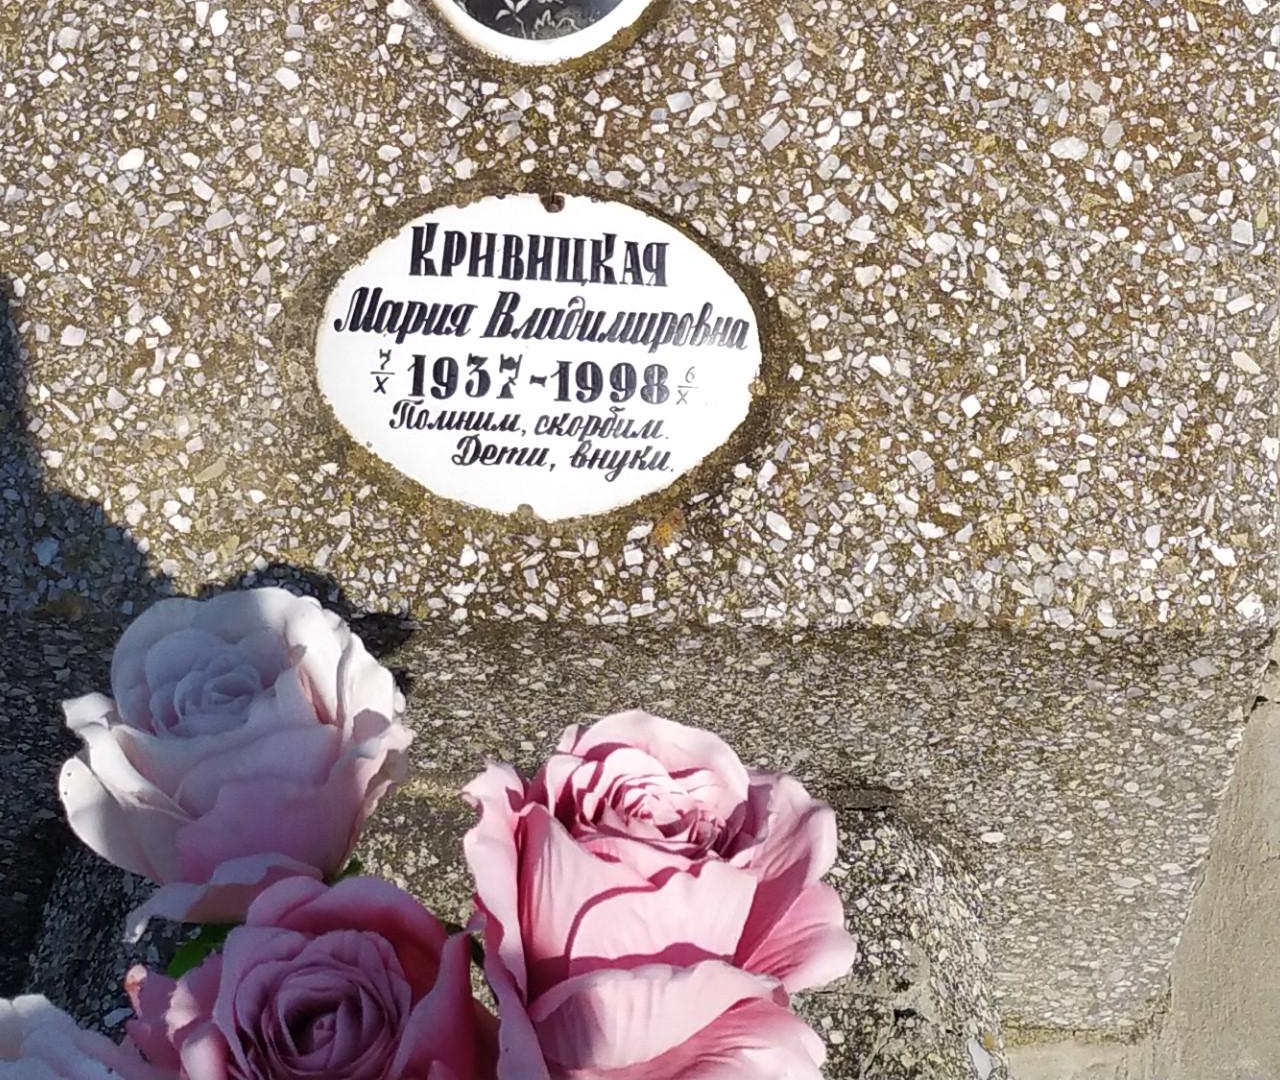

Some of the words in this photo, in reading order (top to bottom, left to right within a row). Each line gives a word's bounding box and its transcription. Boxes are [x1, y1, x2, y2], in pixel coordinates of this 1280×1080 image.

[408, 222, 670, 288] КРИВИЦКАЯ
[332, 286, 478, 345] Мария
[479, 290, 751, 354] Владимировна
[387, 399, 527, 437] Помним,
[533, 406, 670, 443] скорбим.
[450, 434, 556, 473] Дети,
[568, 440, 675, 483] внуки.
